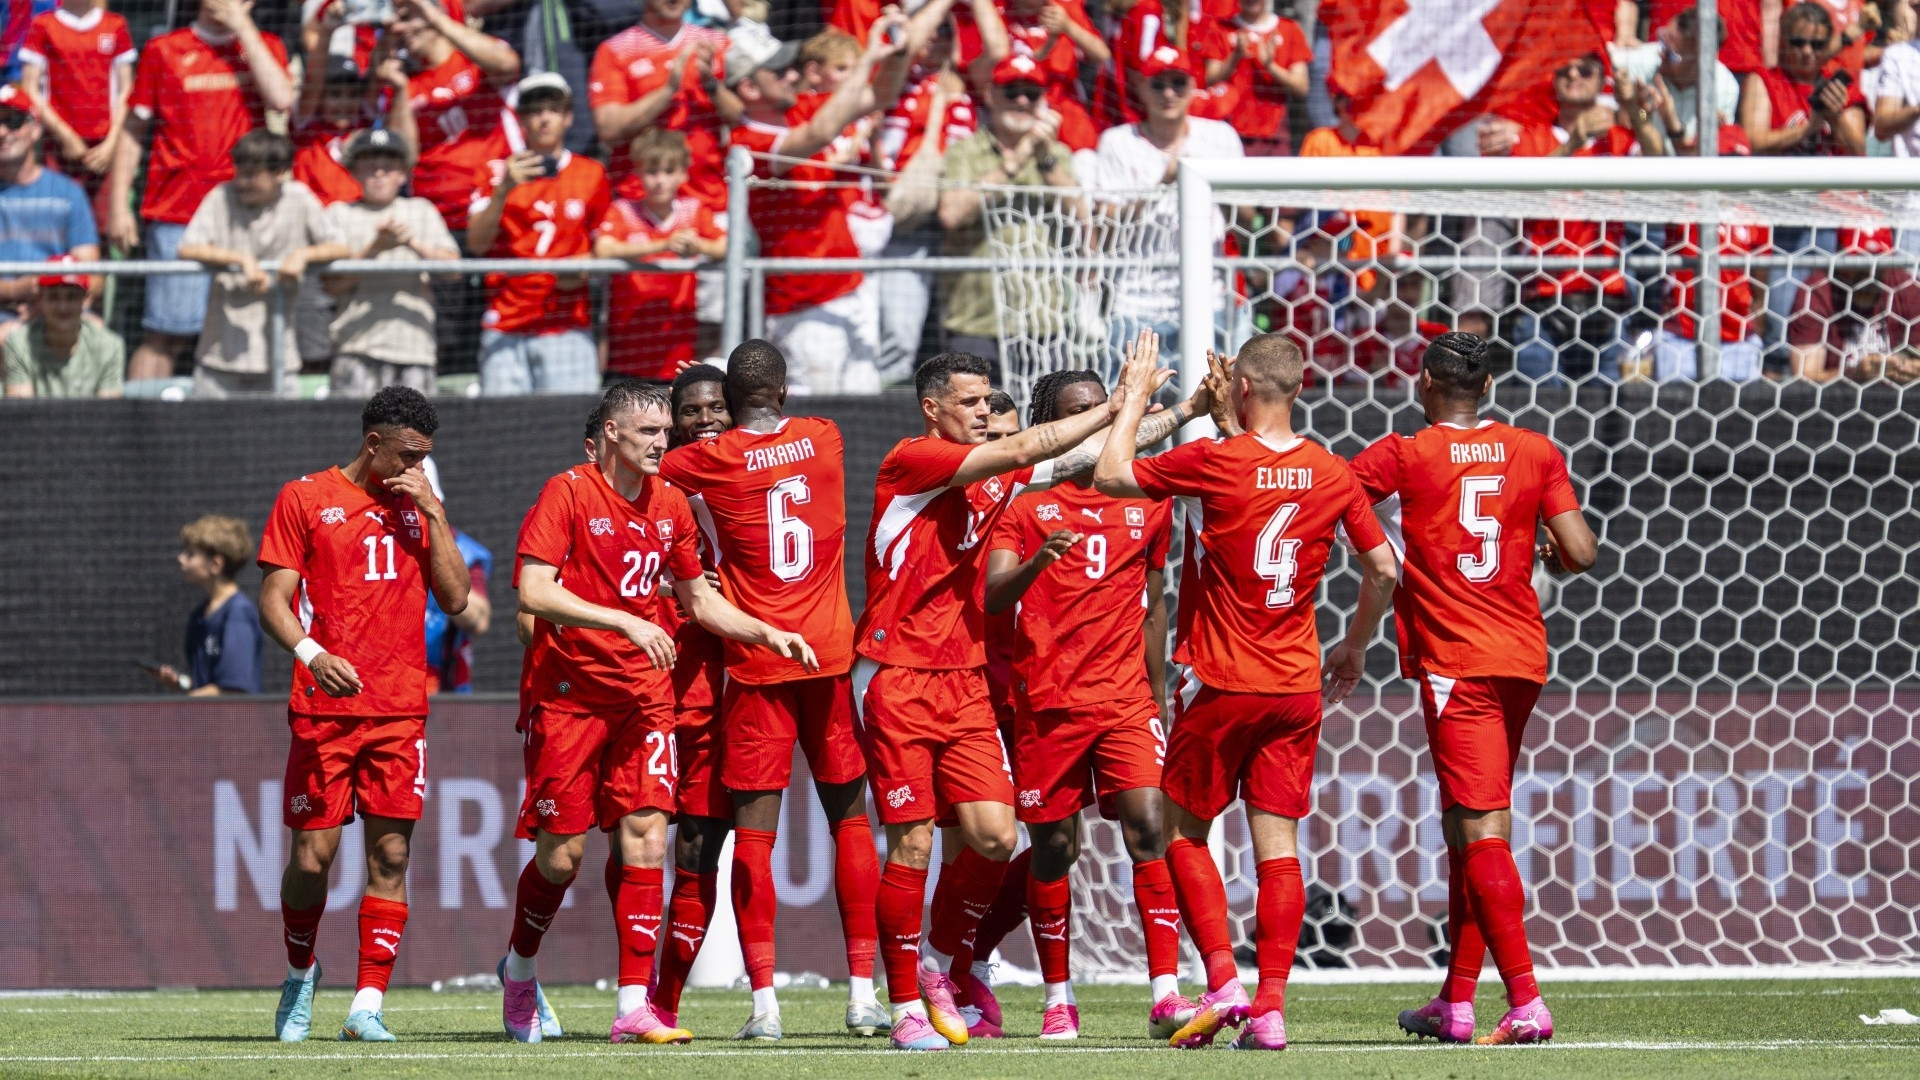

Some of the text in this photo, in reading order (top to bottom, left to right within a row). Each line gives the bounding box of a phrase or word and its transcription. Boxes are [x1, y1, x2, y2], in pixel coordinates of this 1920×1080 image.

[532, 220, 557, 256] 7
[744, 437, 815, 471] ZAKARIA
[1450, 442, 1506, 463] AKANJI
[767, 474, 813, 583] 6
[1457, 475, 1505, 583] 5
[363, 535, 397, 580] 11
[620, 550, 660, 597] 20
[1085, 534, 1107, 579] 9
[1253, 503, 1303, 608] 4
[1149, 717, 1167, 758] 9
